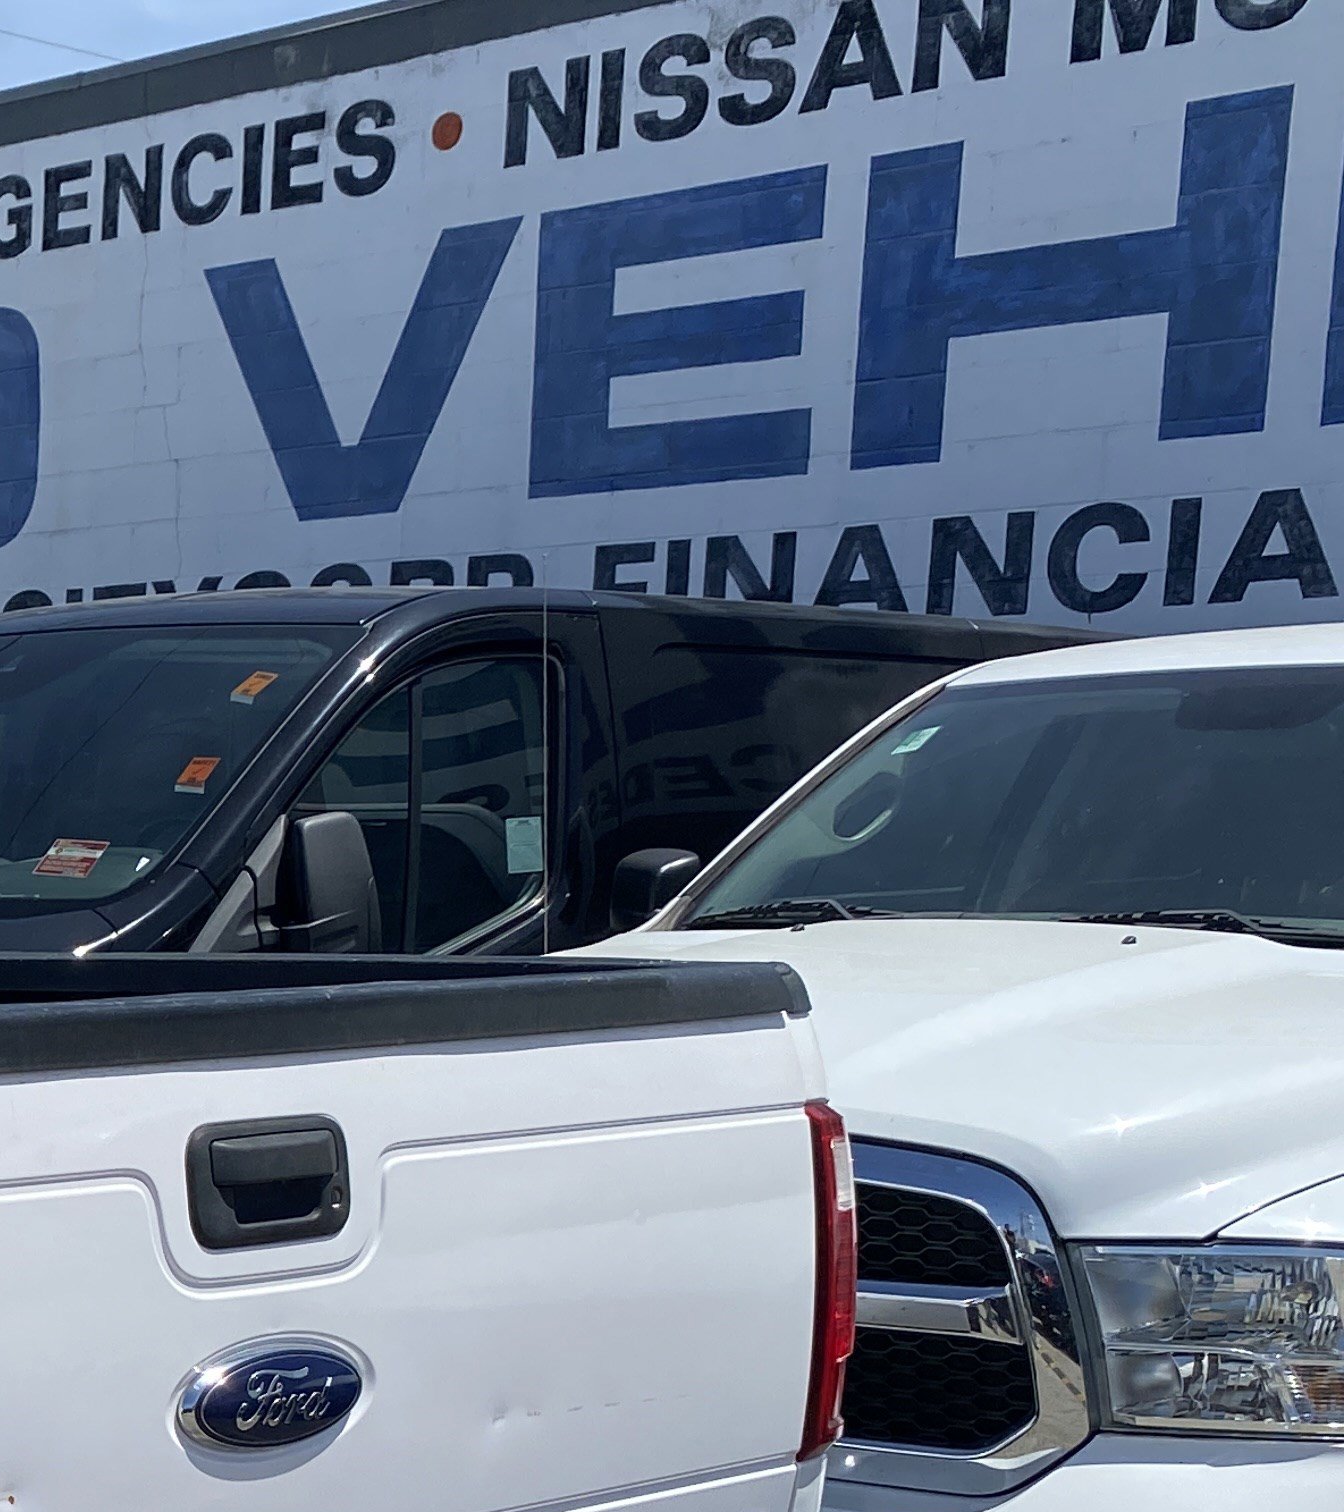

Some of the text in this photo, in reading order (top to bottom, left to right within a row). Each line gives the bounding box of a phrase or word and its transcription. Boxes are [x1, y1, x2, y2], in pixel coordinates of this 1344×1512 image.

[504, 0, 1010, 168] NISSAN
[204, 84, 1344, 522] VEH
[235, 1366, 333, 1431] Ford
